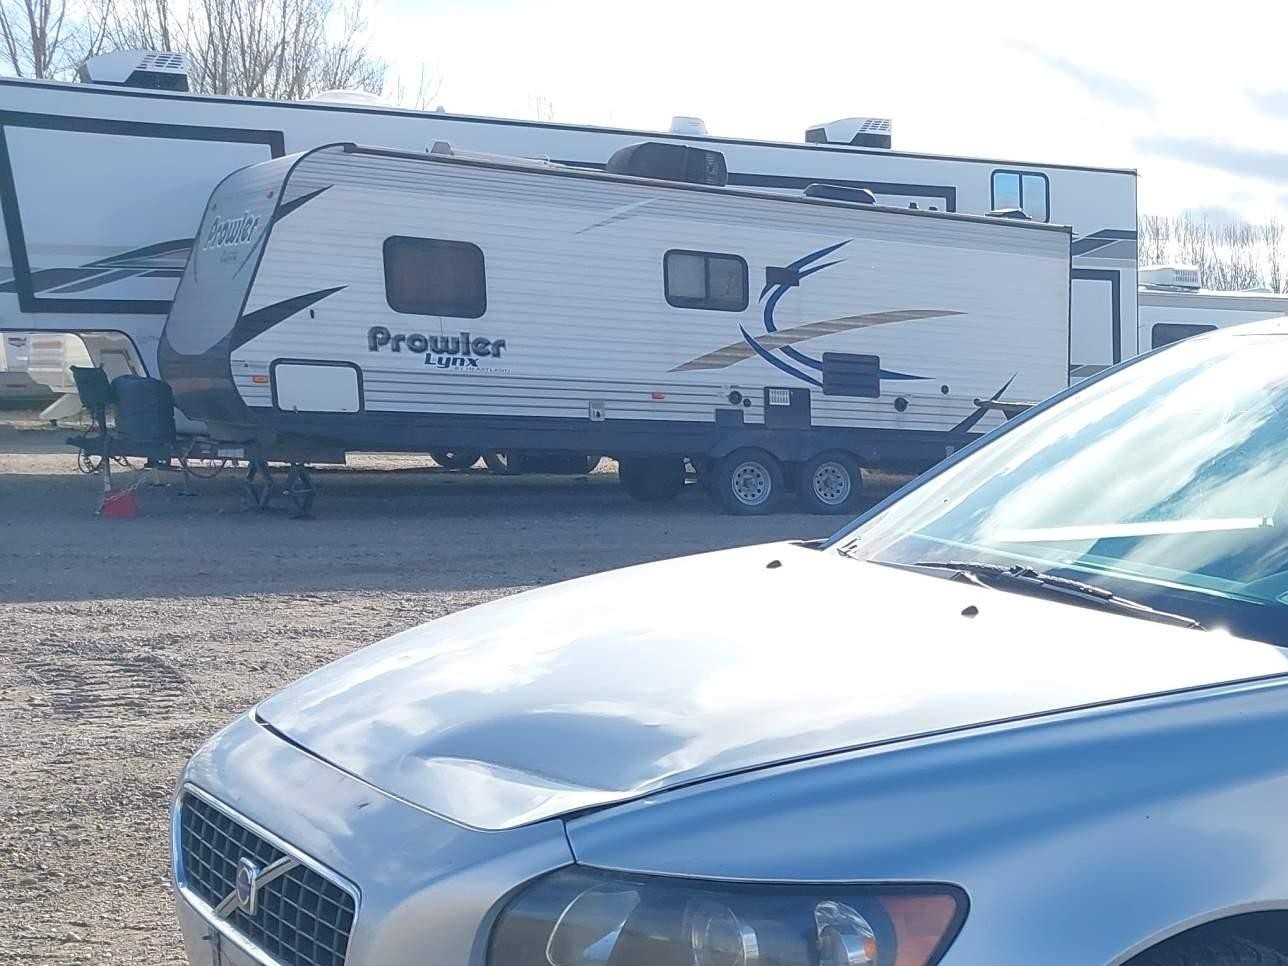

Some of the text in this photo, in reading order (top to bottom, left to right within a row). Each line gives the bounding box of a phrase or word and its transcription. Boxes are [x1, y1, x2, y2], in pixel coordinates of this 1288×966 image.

[203, 211, 261, 251] Prowler
[368, 326, 506, 358] Prowler
[424, 353, 480, 368] Lynx
